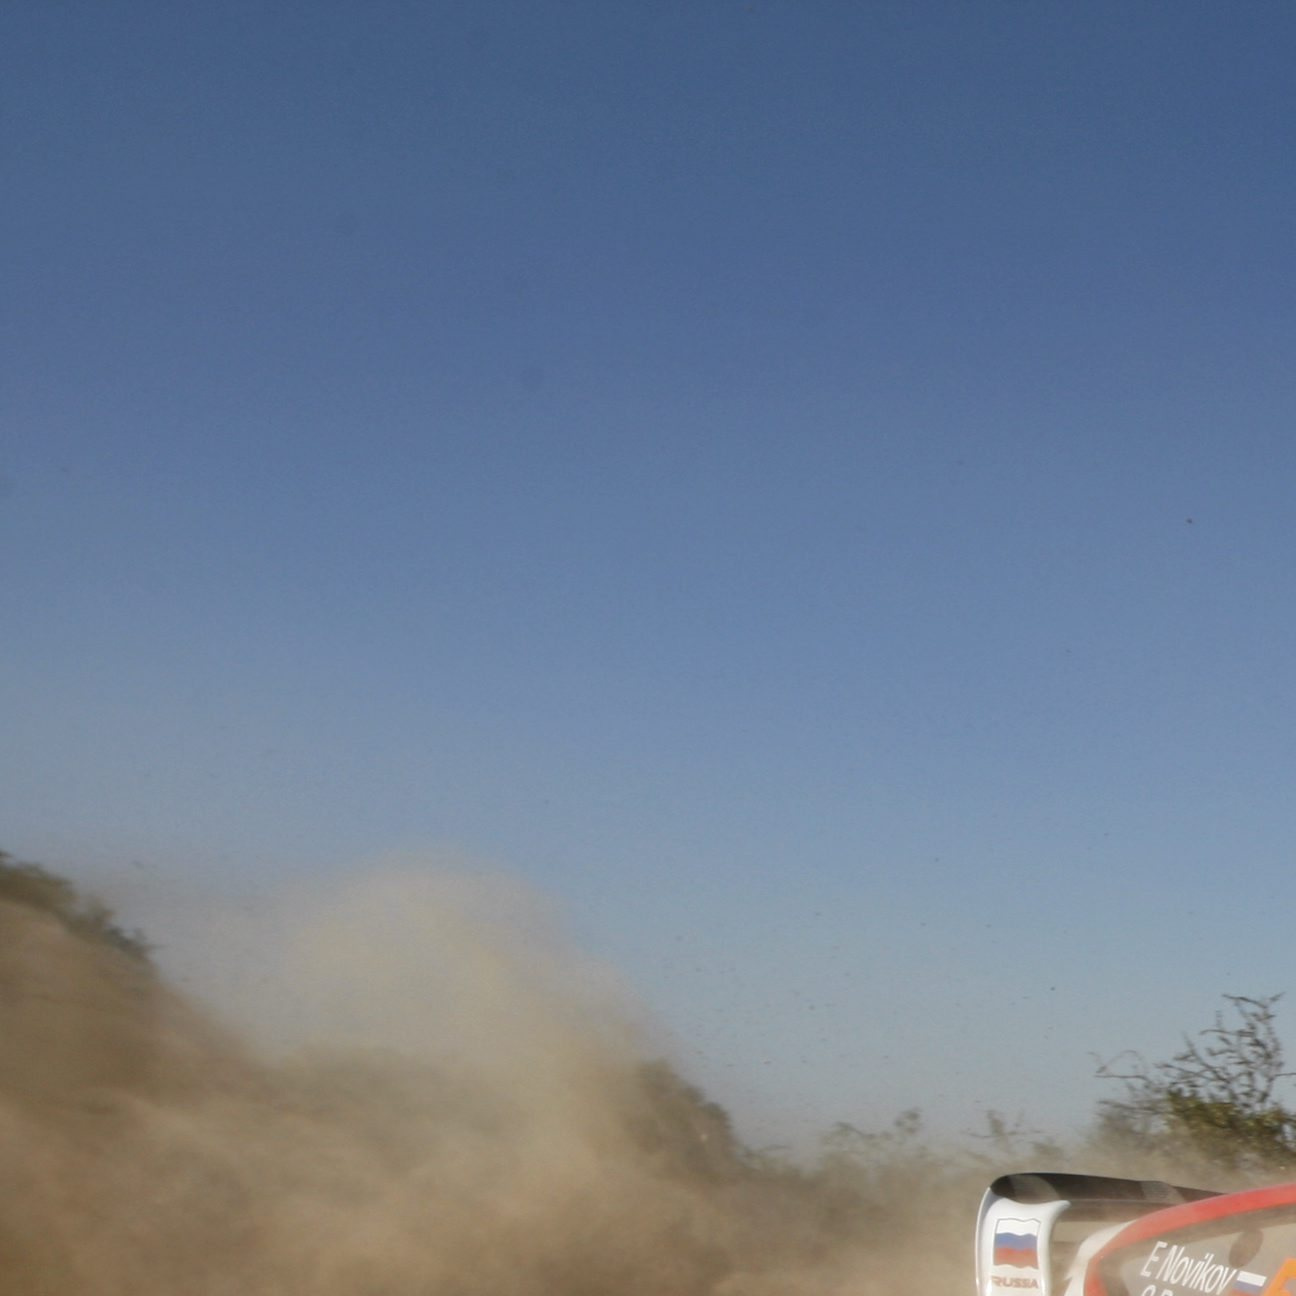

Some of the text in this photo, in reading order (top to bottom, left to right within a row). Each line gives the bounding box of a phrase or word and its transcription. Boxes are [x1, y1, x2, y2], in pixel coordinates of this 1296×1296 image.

[991, 1275, 1039, 1289] RUSSIA
[1140, 1241, 1237, 1295] E Novikov
